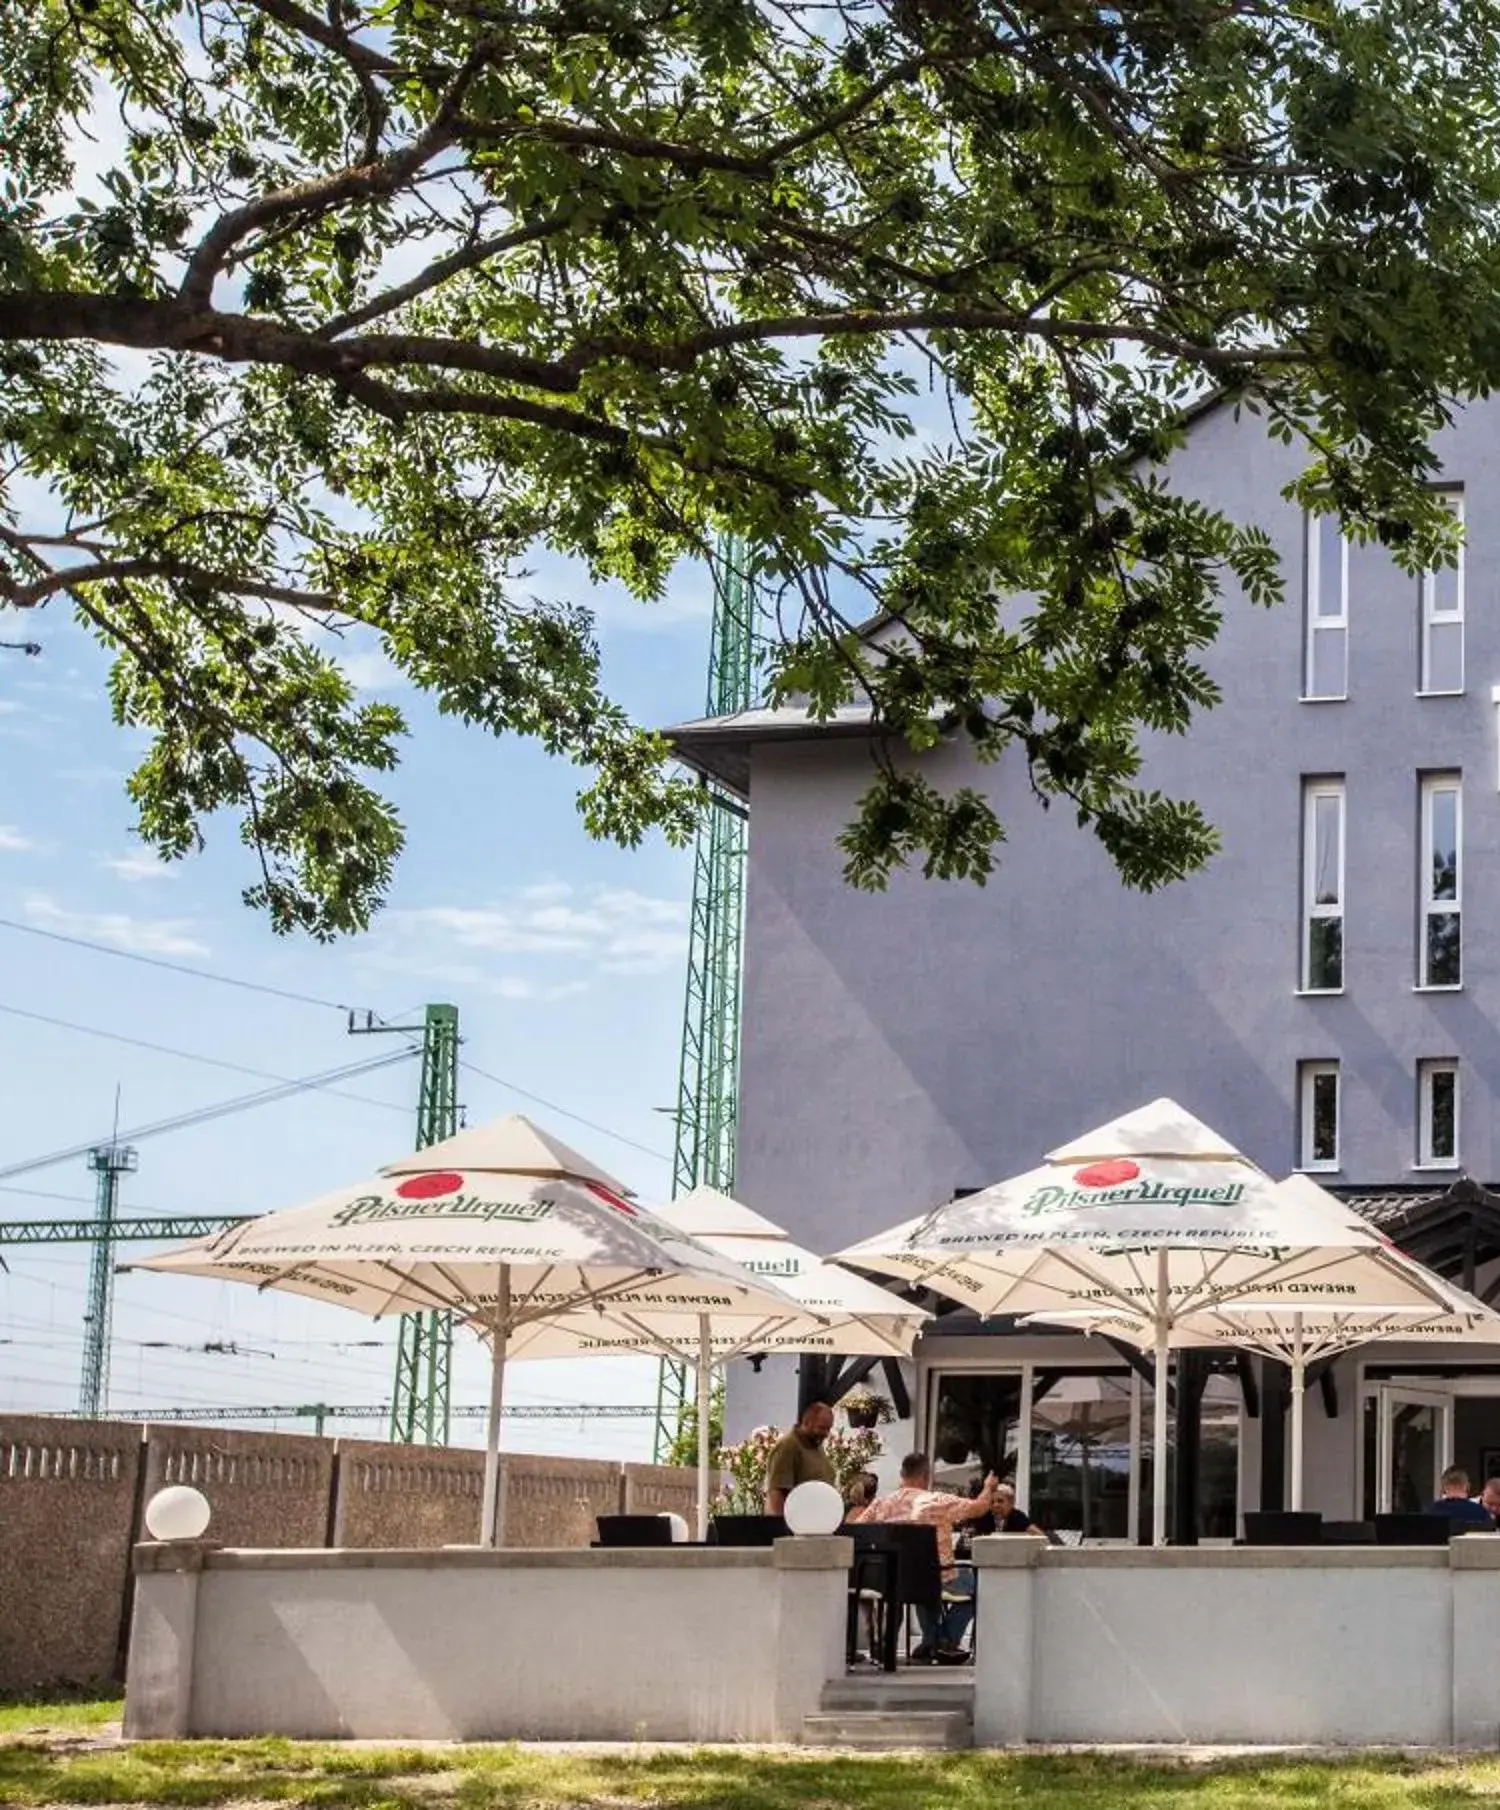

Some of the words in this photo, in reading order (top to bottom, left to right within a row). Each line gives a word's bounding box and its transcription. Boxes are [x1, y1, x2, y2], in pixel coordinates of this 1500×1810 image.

[1022, 1185, 1139, 1217] Pilsner
[1139, 1180, 1245, 1207] Urquell
[327, 1195, 449, 1229] Pilsner
[448, 1194, 555, 1222] Urquell
[939, 1232, 1018, 1244] BREWED
[1023, 1231, 1044, 1241] IN
[1117, 1229, 1181, 1239] CZECH
[1185, 1229, 1277, 1239] REPUBLIC
[237, 1244, 316, 1254] BREWED
[319, 1244, 340, 1252] IN
[409, 1244, 472, 1253] CZECH
[475, 1246, 564, 1257] REPUBLIC
[741, 1257, 800, 1274] quell
